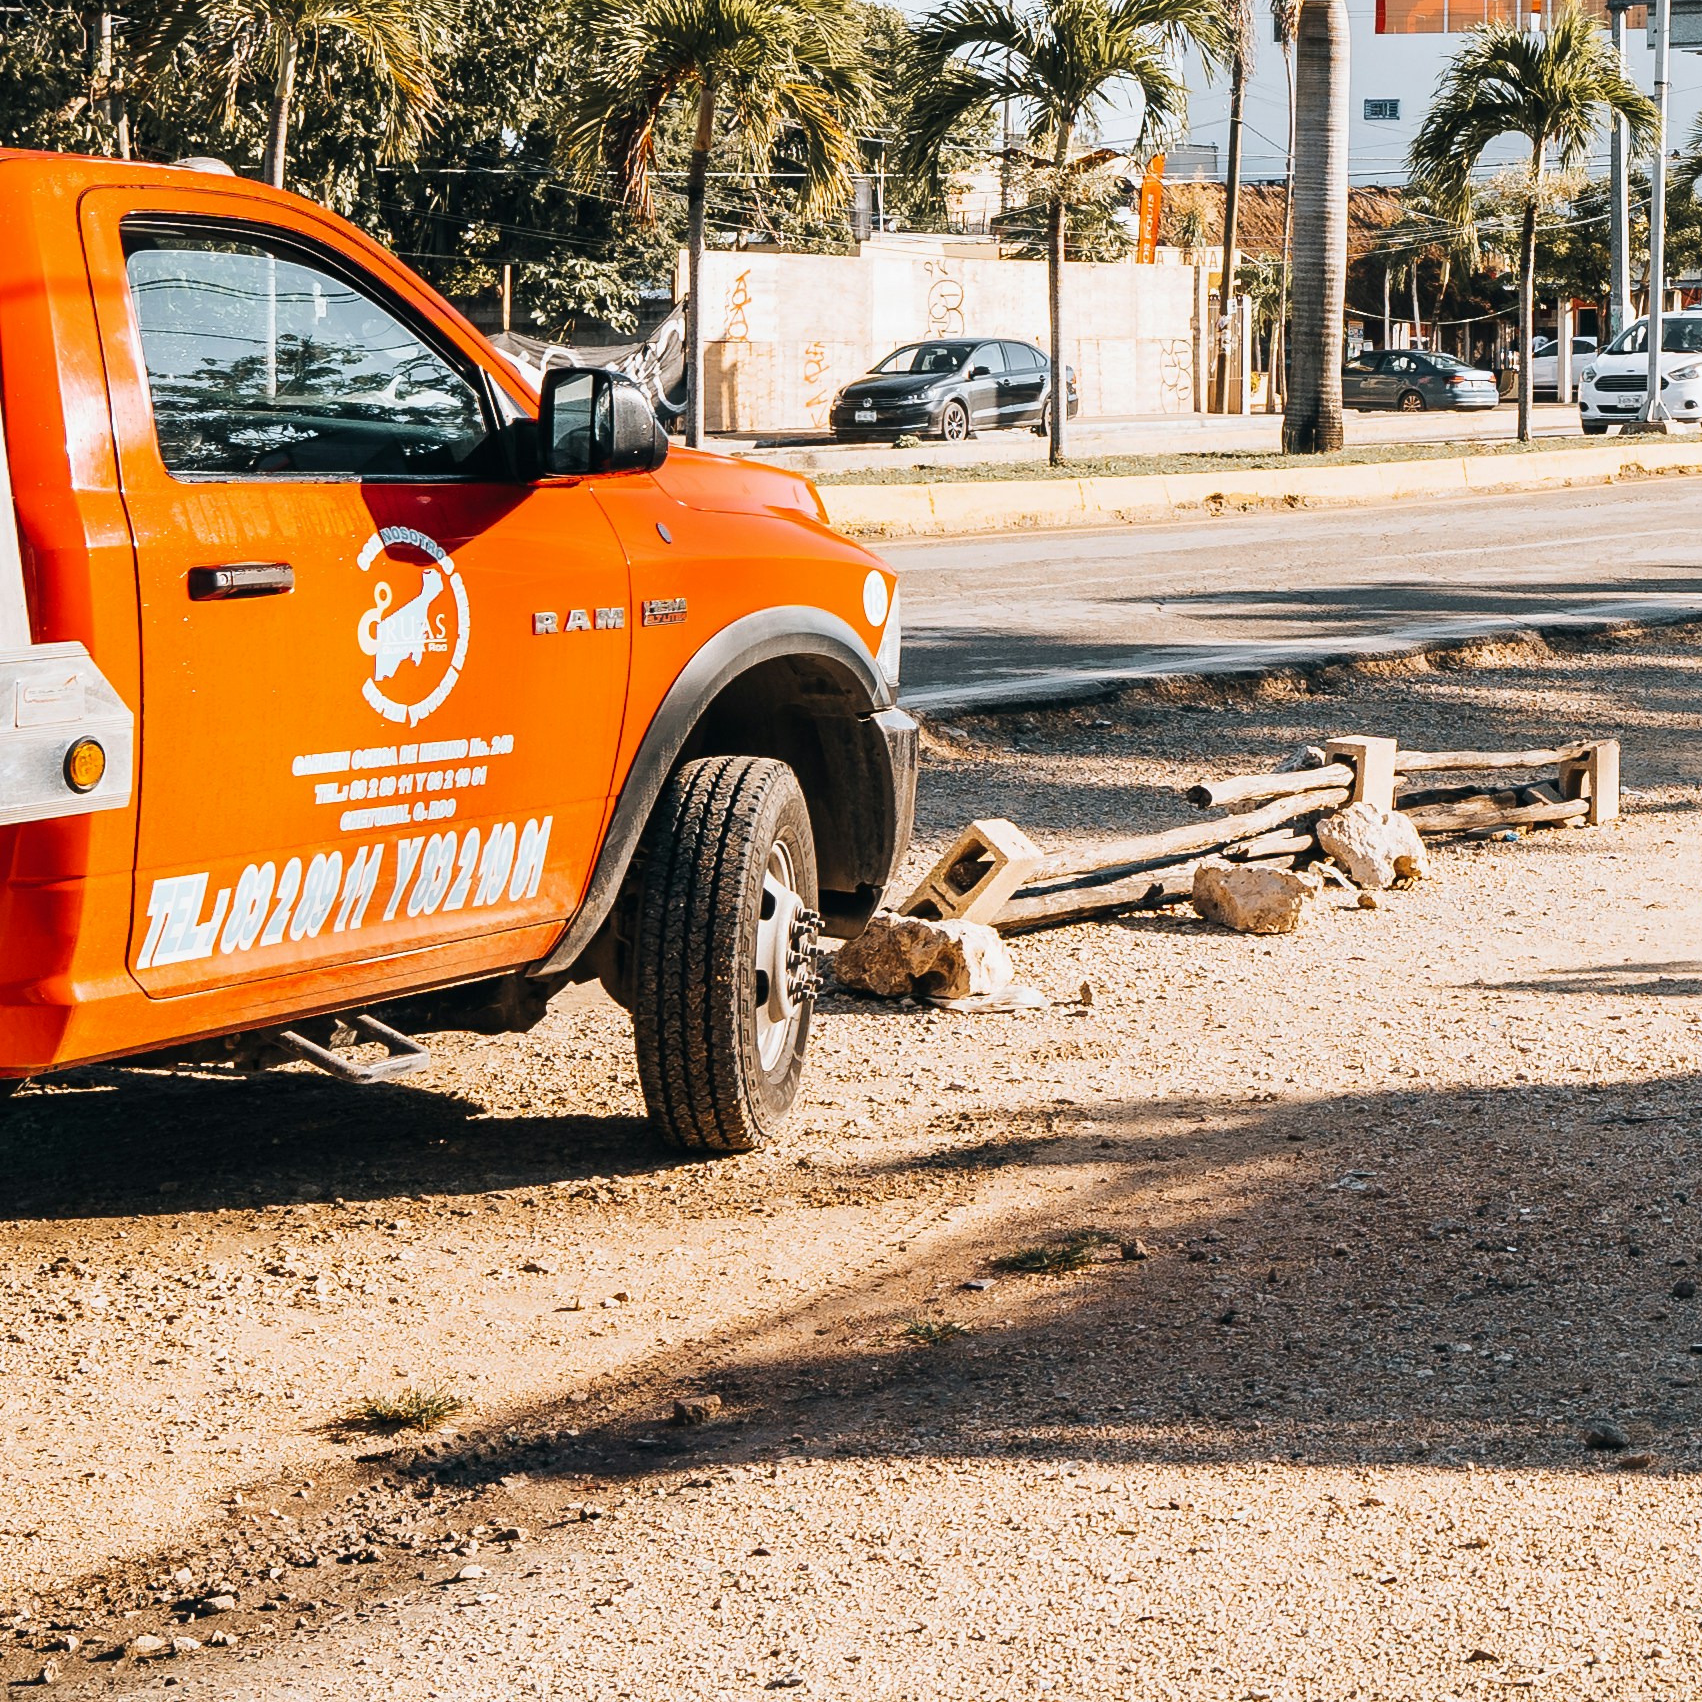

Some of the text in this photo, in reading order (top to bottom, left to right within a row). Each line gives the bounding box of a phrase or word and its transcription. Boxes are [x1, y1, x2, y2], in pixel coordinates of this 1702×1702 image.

[379, 526, 455, 575] NOSOTROS
[533, 607, 625, 635] RAM
[292, 751, 350, 776] CARMEN
[351, 746, 398, 770] OCHOA
[400, 744, 419, 764] DE
[418, 739, 468, 763] MERINO
[469, 738, 490, 757] No.
[367, 778, 378, 798] 2
[398, 773, 414, 794] 11
[415, 772, 427, 792] Y
[443, 769, 454, 789] 2
[340, 804, 411, 831] CHETUMAL
[427, 798, 457, 820] ROO
[220, 861, 276, 954] 83
[260, 857, 302, 946] 2
[289, 850, 343, 941] 89
[333, 843, 384, 933] 11
[383, 836, 426, 921] Y
[406, 831, 458, 918] 83
[442, 827, 480, 911] 2
[472, 821, 517, 907] 19
[509, 815, 553, 902] 81
